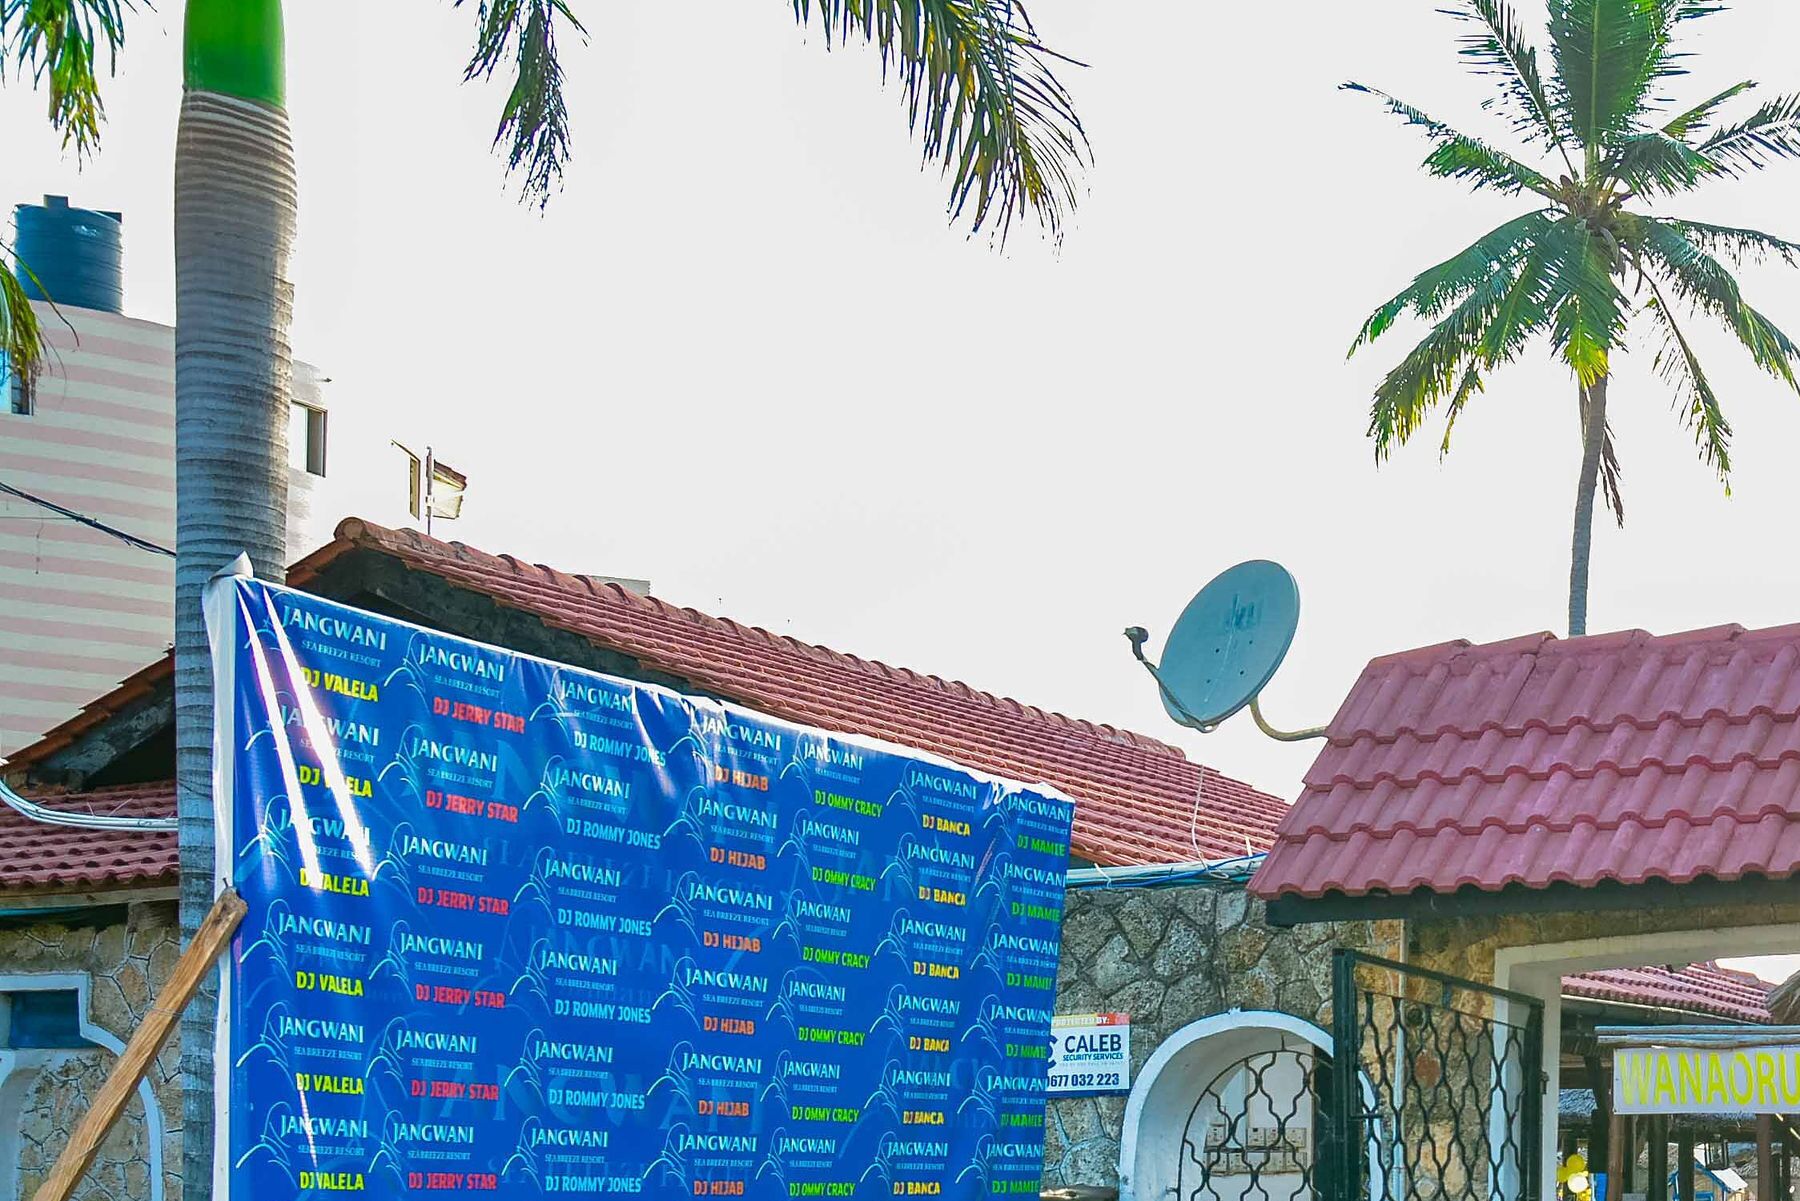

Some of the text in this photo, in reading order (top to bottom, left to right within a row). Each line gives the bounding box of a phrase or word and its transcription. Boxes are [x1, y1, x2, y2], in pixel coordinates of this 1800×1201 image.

[420, 643, 504, 682] JANGWANI
[434, 697, 525, 734] DJ JERRY STAR
[554, 767, 631, 799] JANGWANI
[911, 770, 977, 799] JANGWANI
[698, 797, 777, 829] JANGWANI
[922, 814, 971, 836] DJ BANCA
[567, 818, 661, 849] DJ ROMMY JONES
[710, 847, 766, 870] DJ HIJAB
[797, 900, 850, 923] JANGWANI
[1012, 902, 1025, 916] DJ
[279, 912, 371, 945] JANGWANI
[803, 946, 870, 968] DJ OMMY CRACY
[296, 971, 364, 996] DJ VALELA
[1064, 1034, 1122, 1054] CALEB
[1063, 1052, 1124, 1062] SECURITY SERVICES
[1071, 1073, 1094, 1087] 032
[1097, 1072, 1120, 1086] 223
